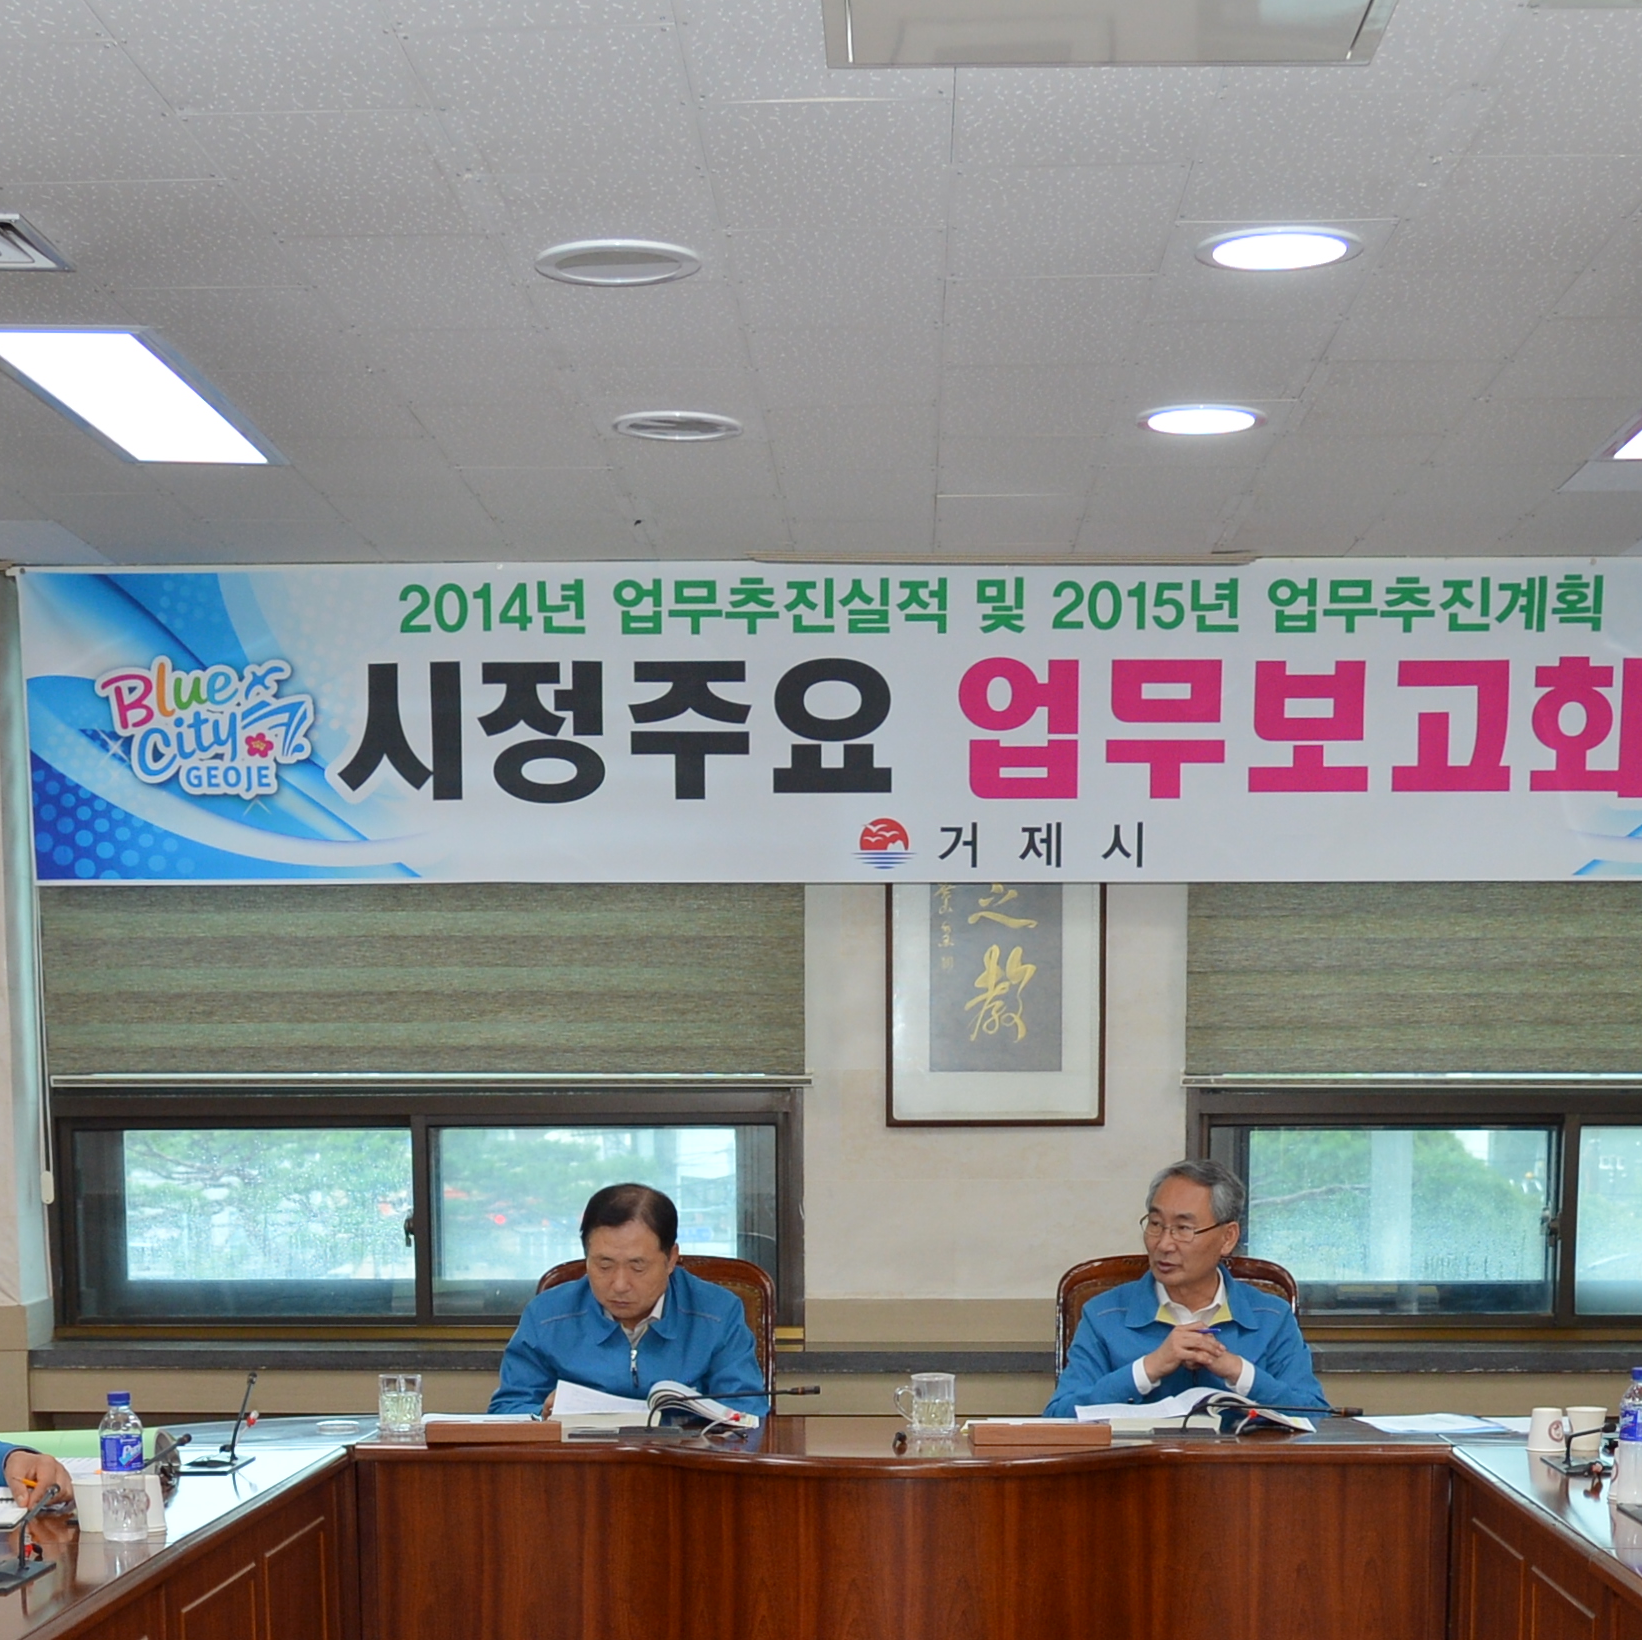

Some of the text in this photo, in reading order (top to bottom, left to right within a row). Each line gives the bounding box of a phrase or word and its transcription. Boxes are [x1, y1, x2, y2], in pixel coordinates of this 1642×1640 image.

[400, 574, 1604, 634] 2014년 업무추진실적 및 2015년 업무추진계획
[101, 662, 239, 730] Blue
[138, 711, 237, 777] City
[338, 658, 891, 803] 시정주요
[185, 765, 271, 793] GEOJE
